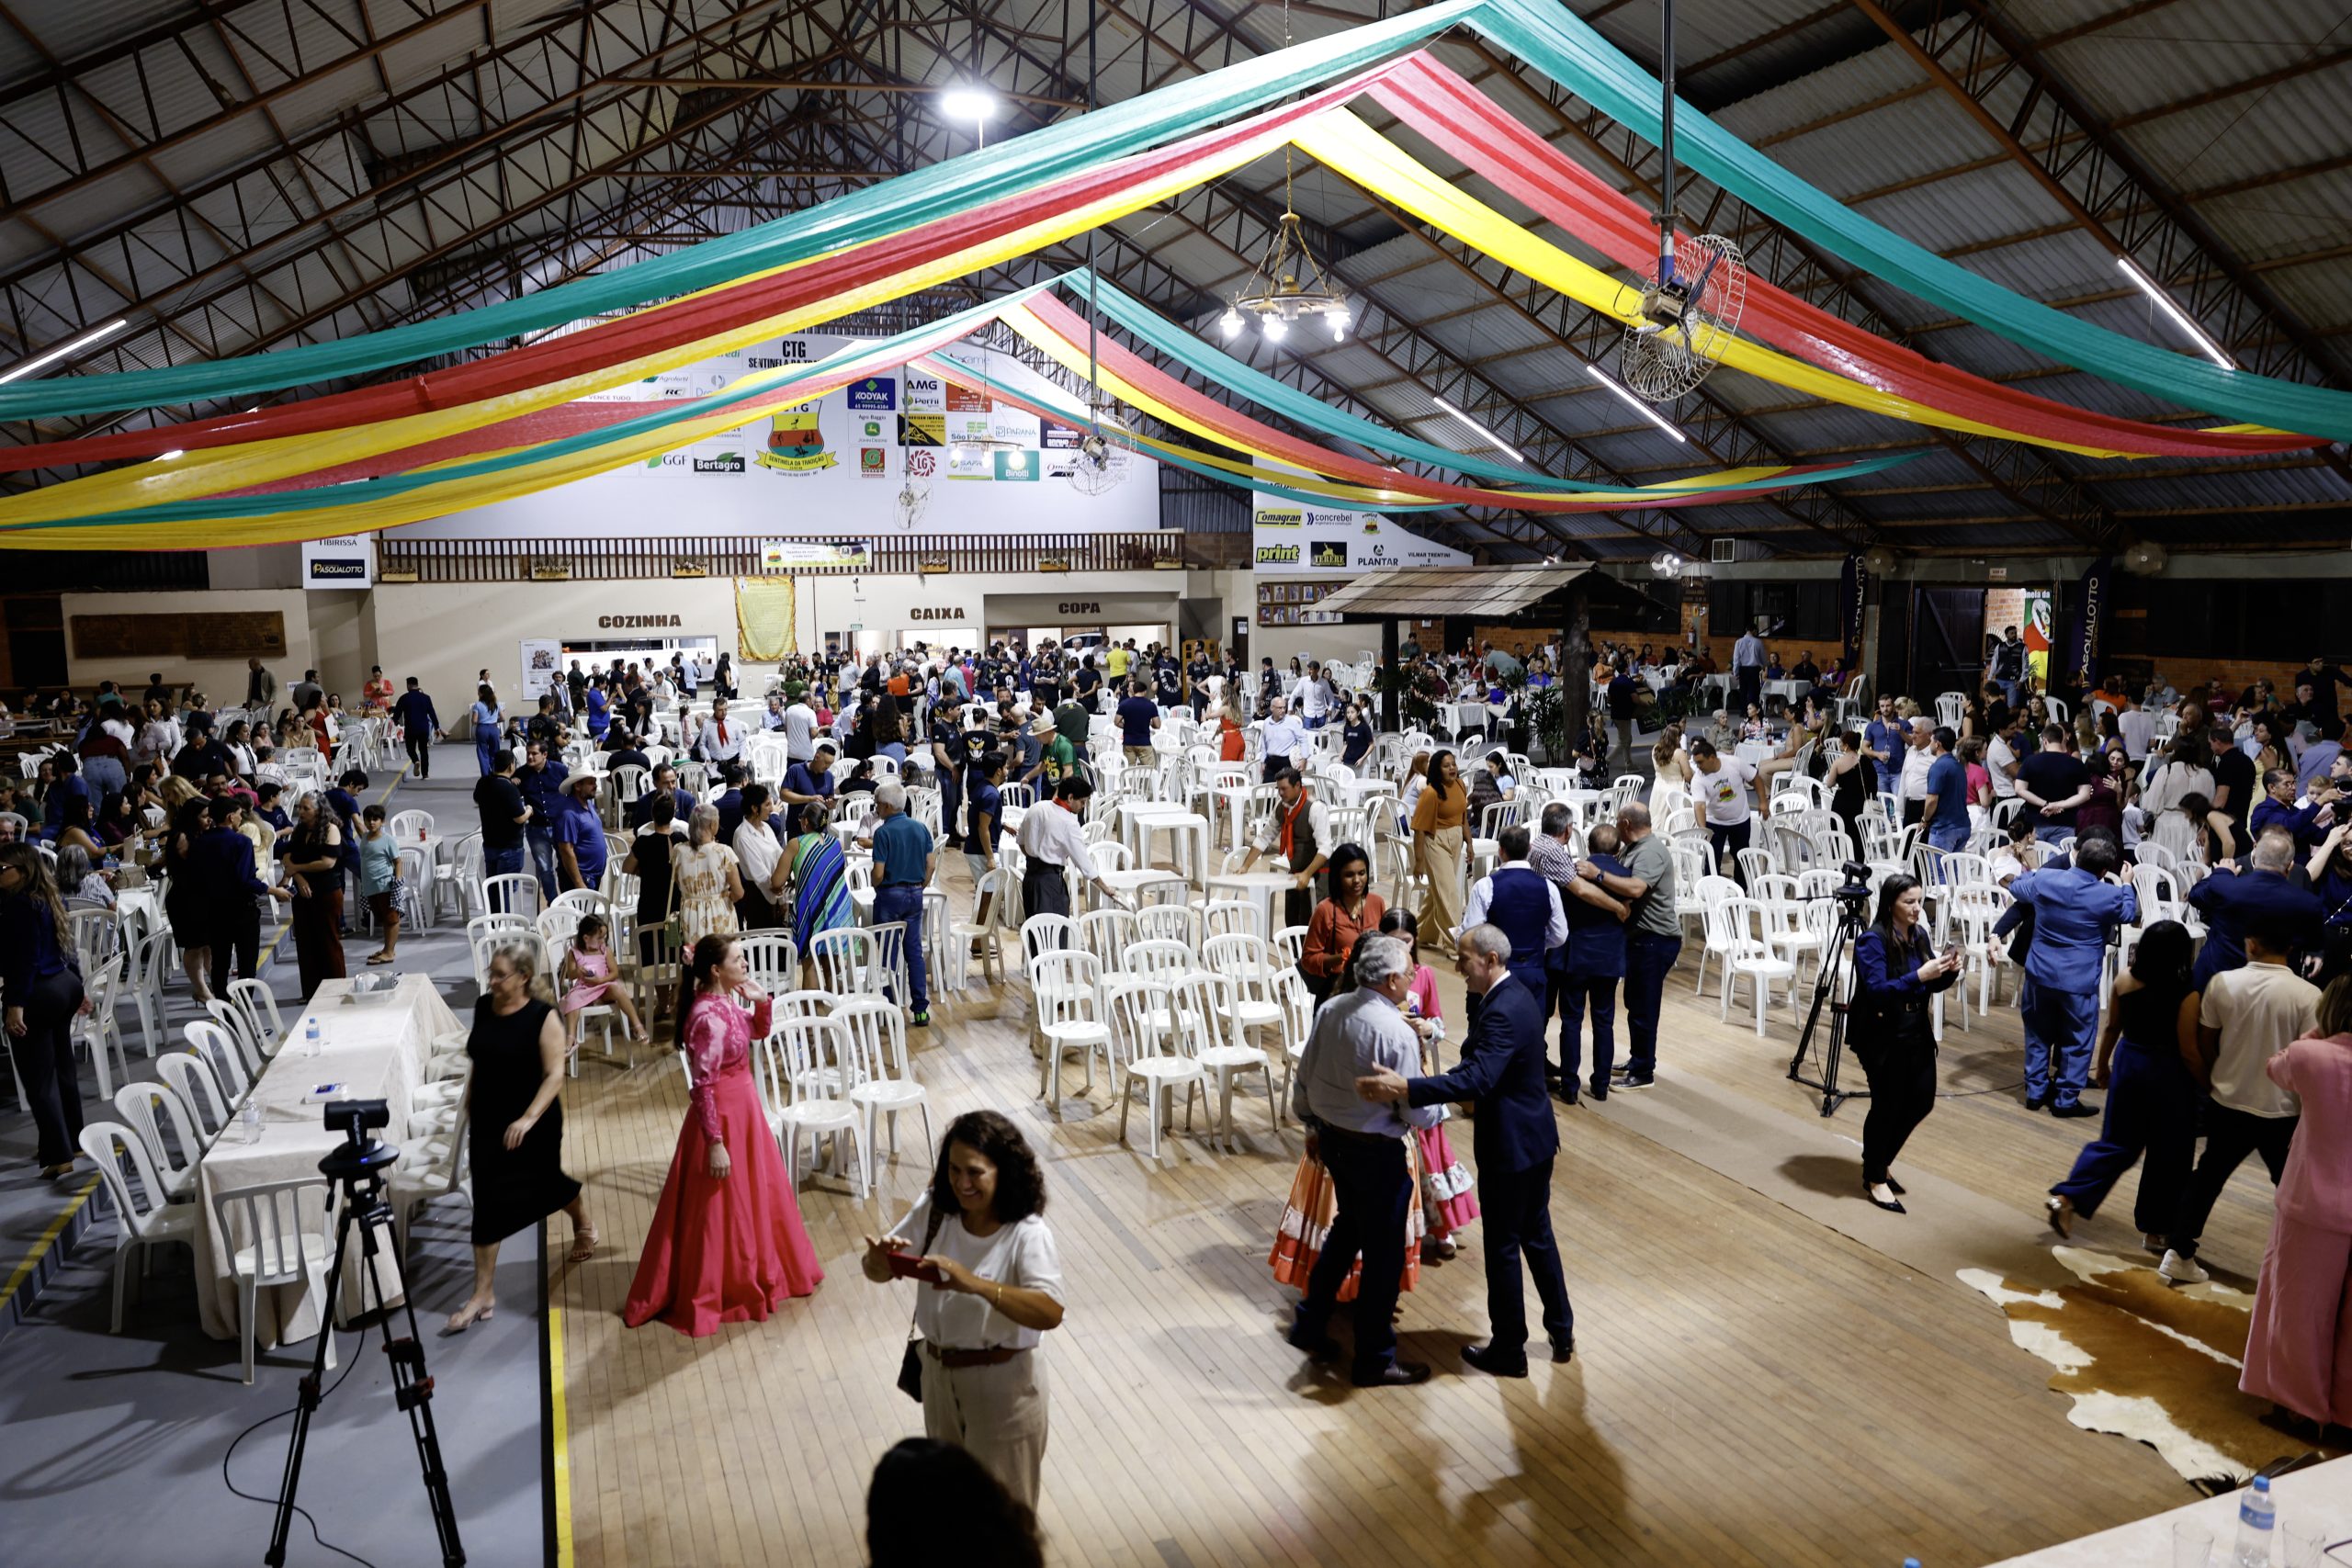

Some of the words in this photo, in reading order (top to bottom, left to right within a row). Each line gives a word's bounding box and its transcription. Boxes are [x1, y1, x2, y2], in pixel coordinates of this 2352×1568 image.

[782, 340, 806, 357] CTG
[748, 357, 789, 368] SENTINELA
[907, 379, 938, 390] AMG
[854, 390, 888, 401] KODYAK
[914, 397, 939, 405] Perfil
[662, 455, 687, 466] GGF
[696, 460, 741, 471] Bertagro
[768, 455, 794, 466] SENTINELA
[802, 456, 825, 466] TRADIÇÃO
[917, 457, 928, 469] LG
[1005, 469, 1029, 478] Binotti
[1255, 511, 1302, 525] Comagran
[1315, 513, 1352, 522] concrebel
[1256, 544, 1300, 563] print
[1357, 558, 1398, 566] PLANTAR
[313, 563, 363, 574] PASQUALOTTO
[910, 607, 965, 620] CAIXA
[1058, 603, 1101, 614] COPA
[598, 615, 682, 628] COZINHA
